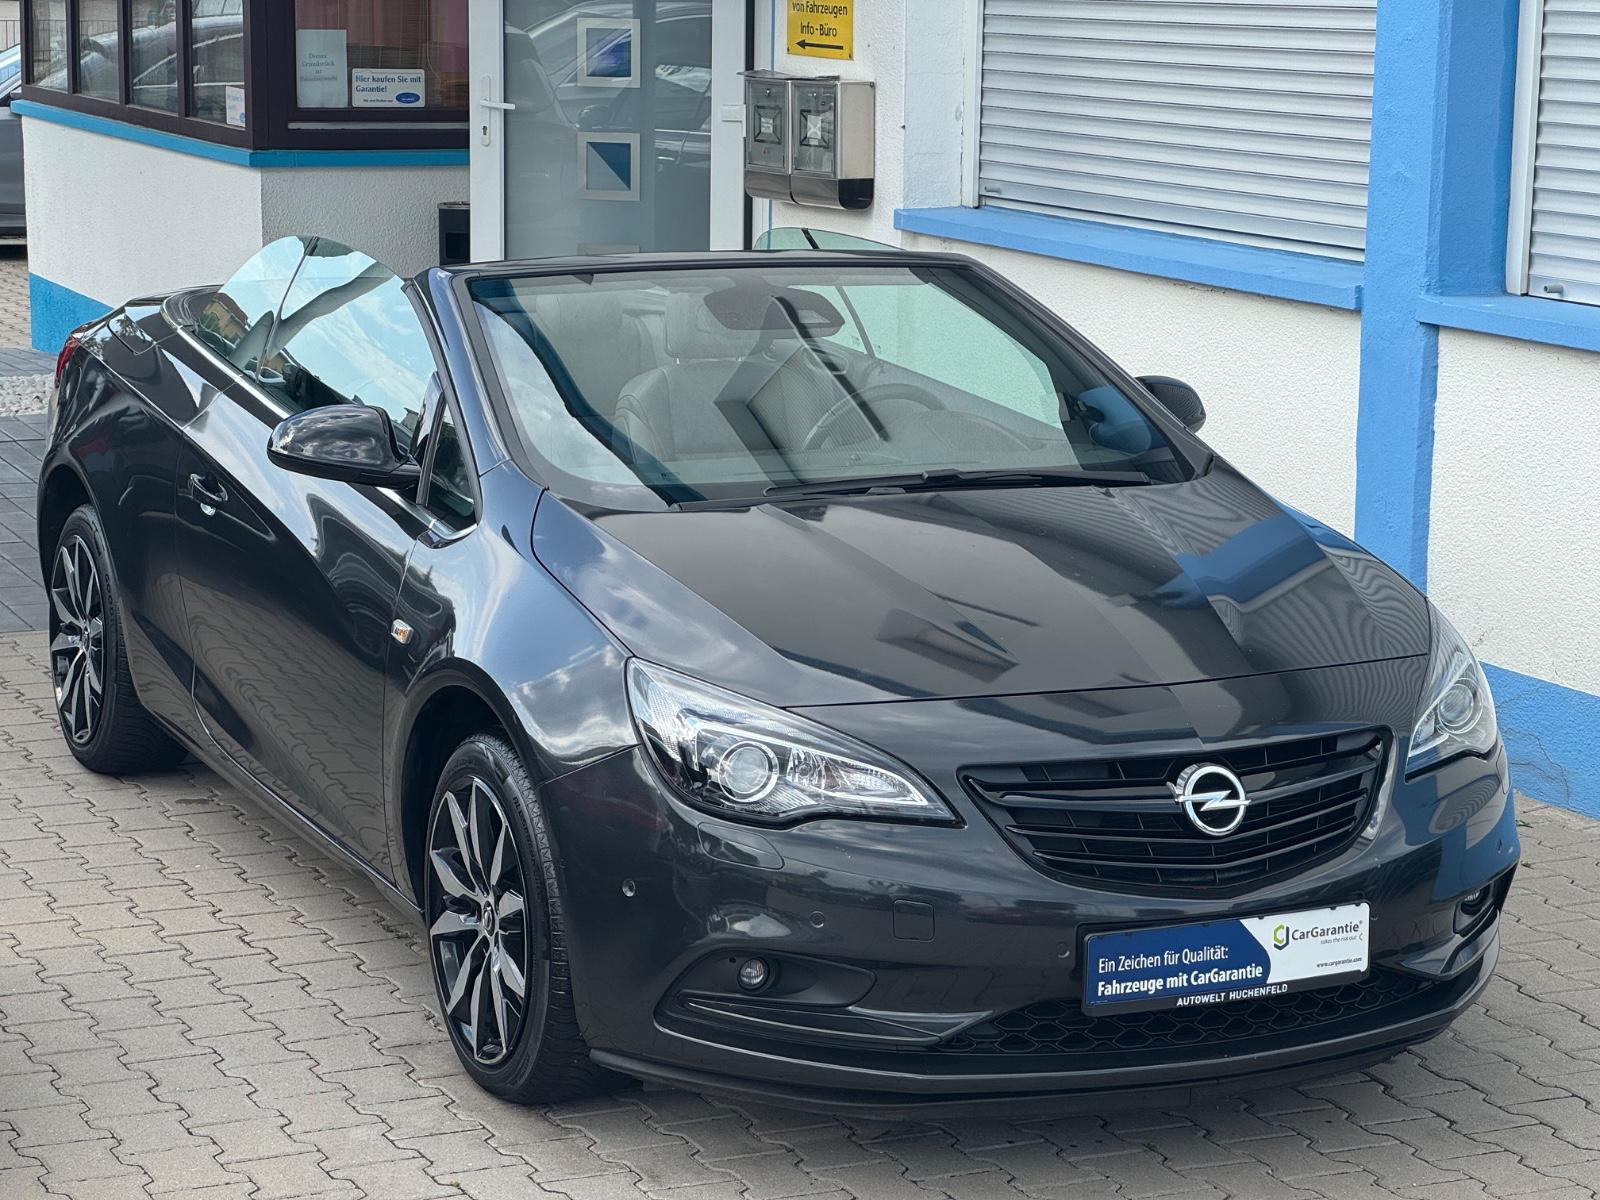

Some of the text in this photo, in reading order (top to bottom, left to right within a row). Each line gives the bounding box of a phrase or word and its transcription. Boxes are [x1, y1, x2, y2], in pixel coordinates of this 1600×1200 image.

[792, 1, 848, 18] von Fahrzeugen
[355, 74, 421, 83] Hier kaufen Sie mit
[355, 85, 387, 93] Garantie!
[1098, 945, 1229, 974] Ein Zeichen für Qualität:
[1316, 957, 1362, 968] www.cargarantie.com
[1098, 963, 1263, 997] Fahrzeuge mit CarGarantie
[1176, 983, 1288, 1006] AUTOWELT HUCHENFELD
